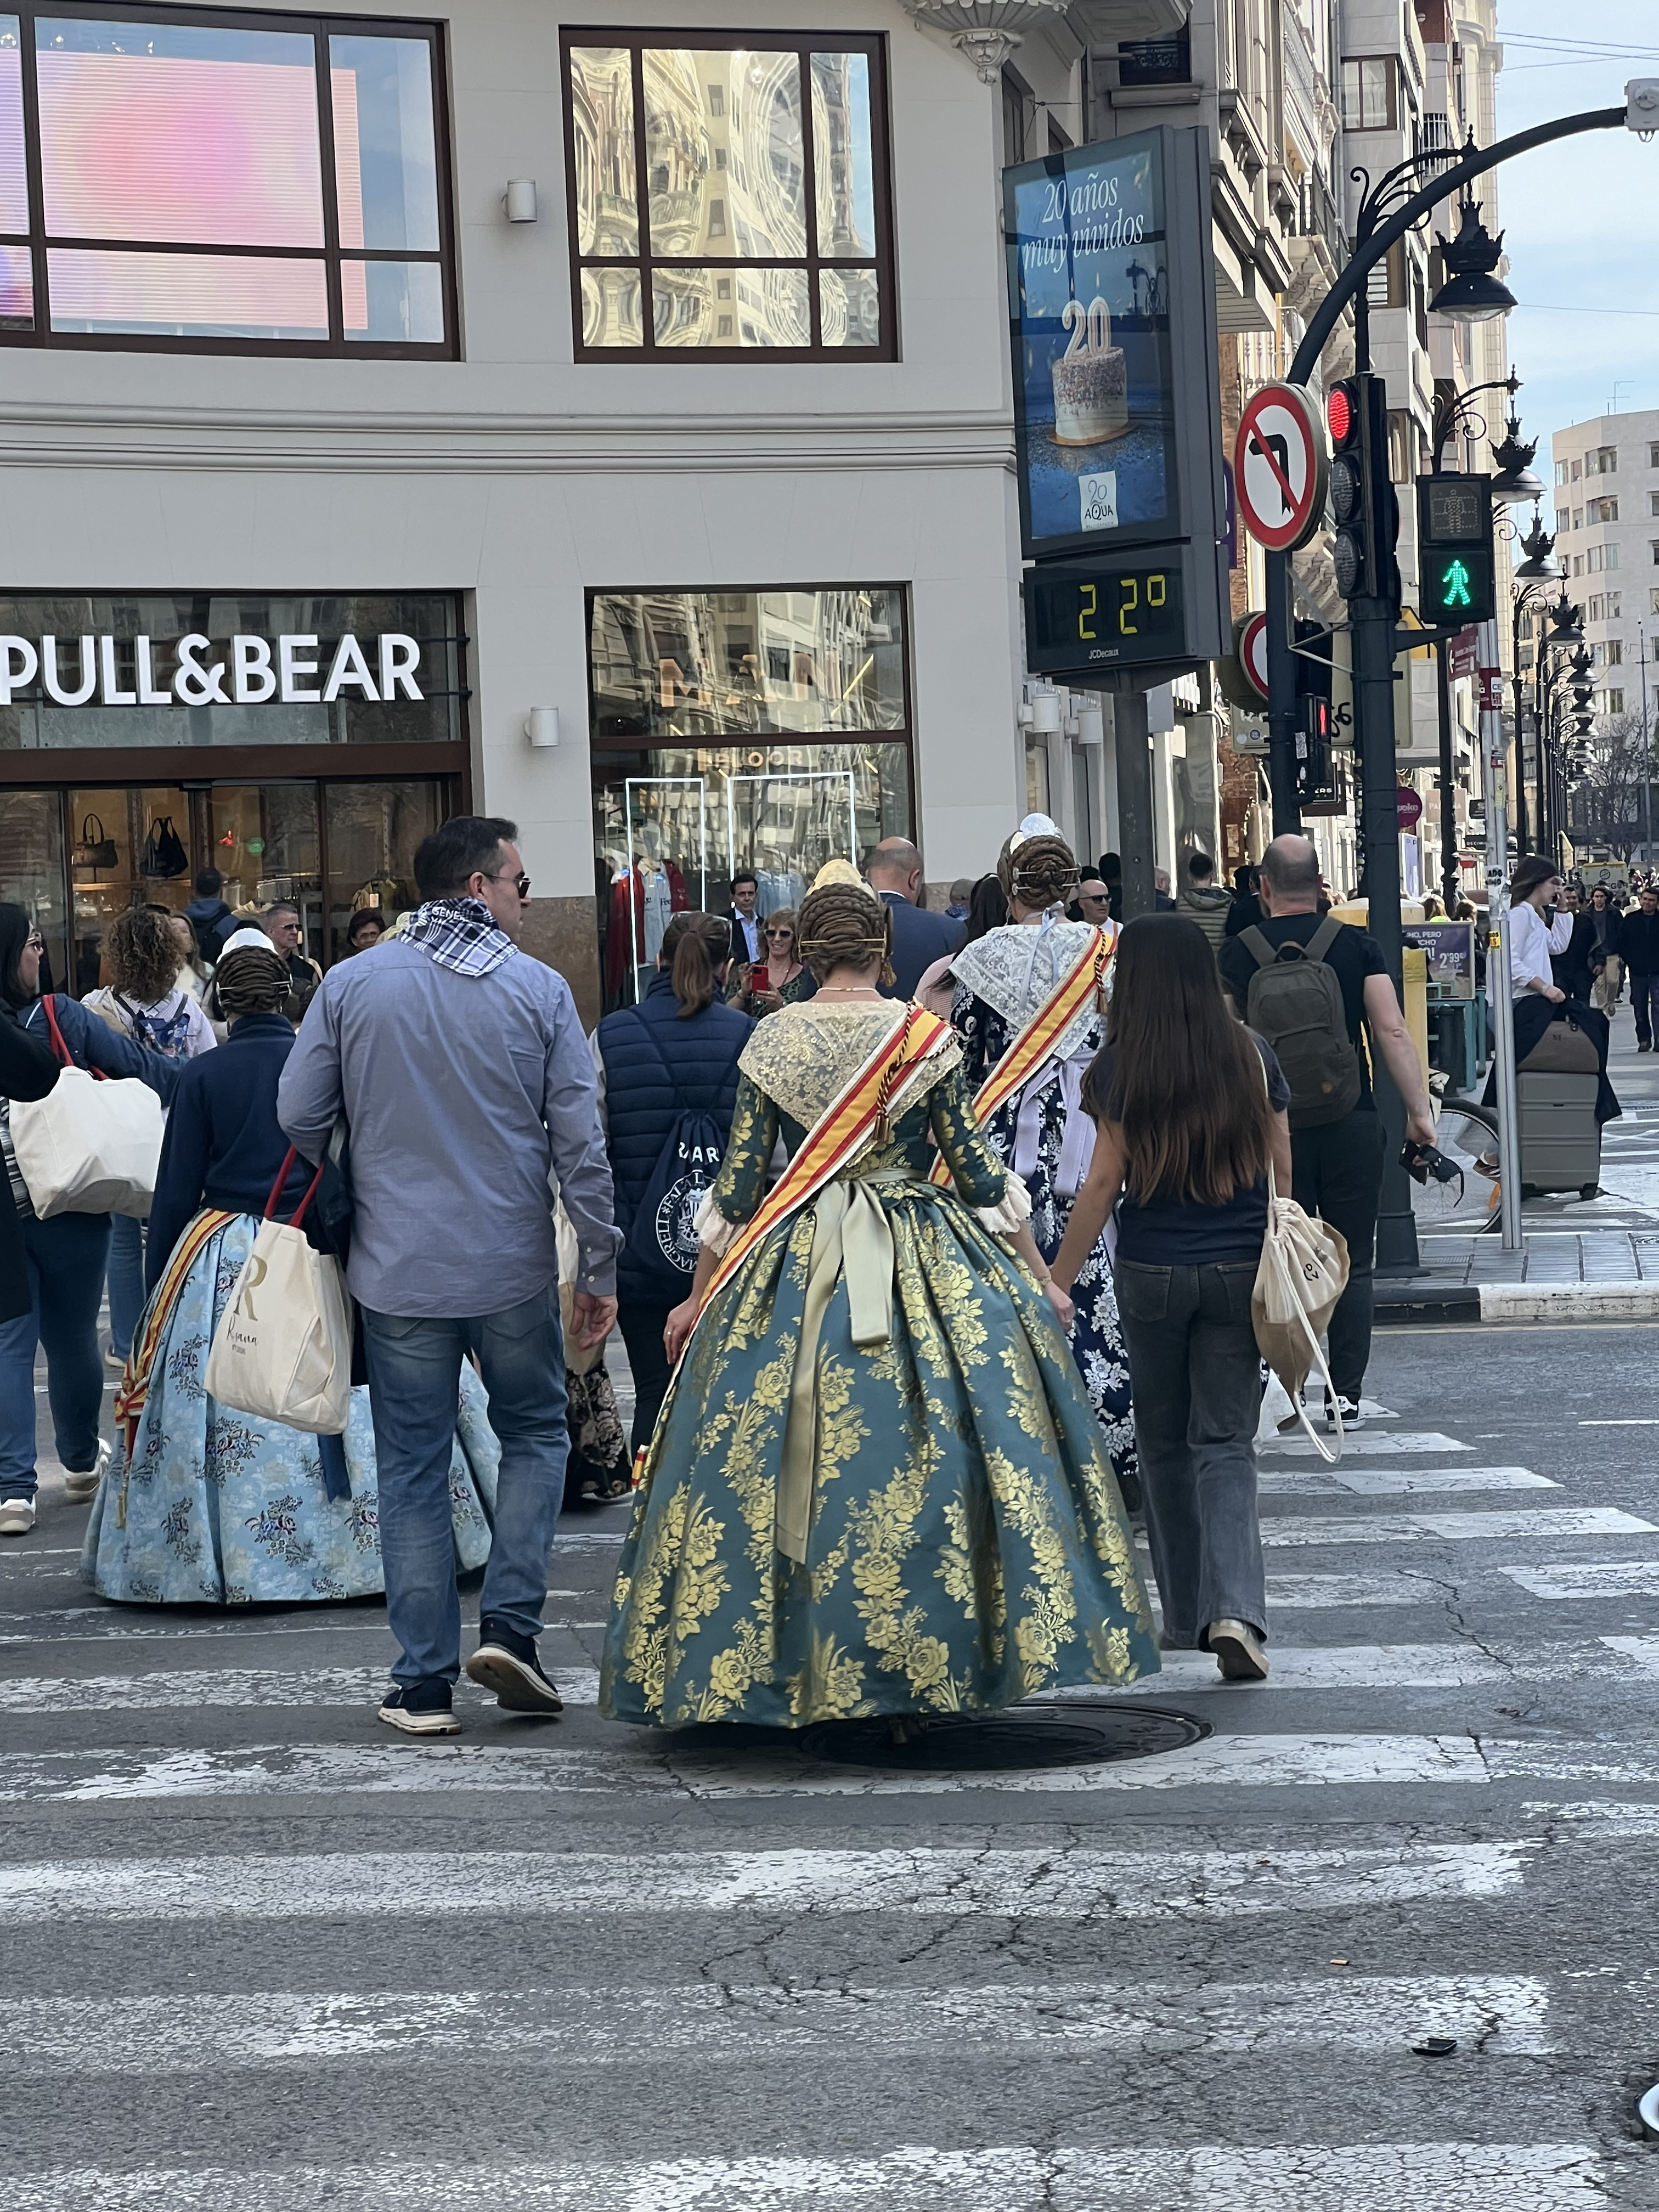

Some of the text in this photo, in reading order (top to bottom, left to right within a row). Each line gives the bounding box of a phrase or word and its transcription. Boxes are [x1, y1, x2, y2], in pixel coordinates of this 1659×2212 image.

[1042, 171, 1118, 223] 20 años
[1023, 207, 1144, 273] muy vividos
[1062, 296, 1111, 363] 20
[1084, 504, 1114, 521] AQUA
[0, 633, 425, 707] PULL&BEAR
[1088, 648, 1120, 659] JCDecaux
